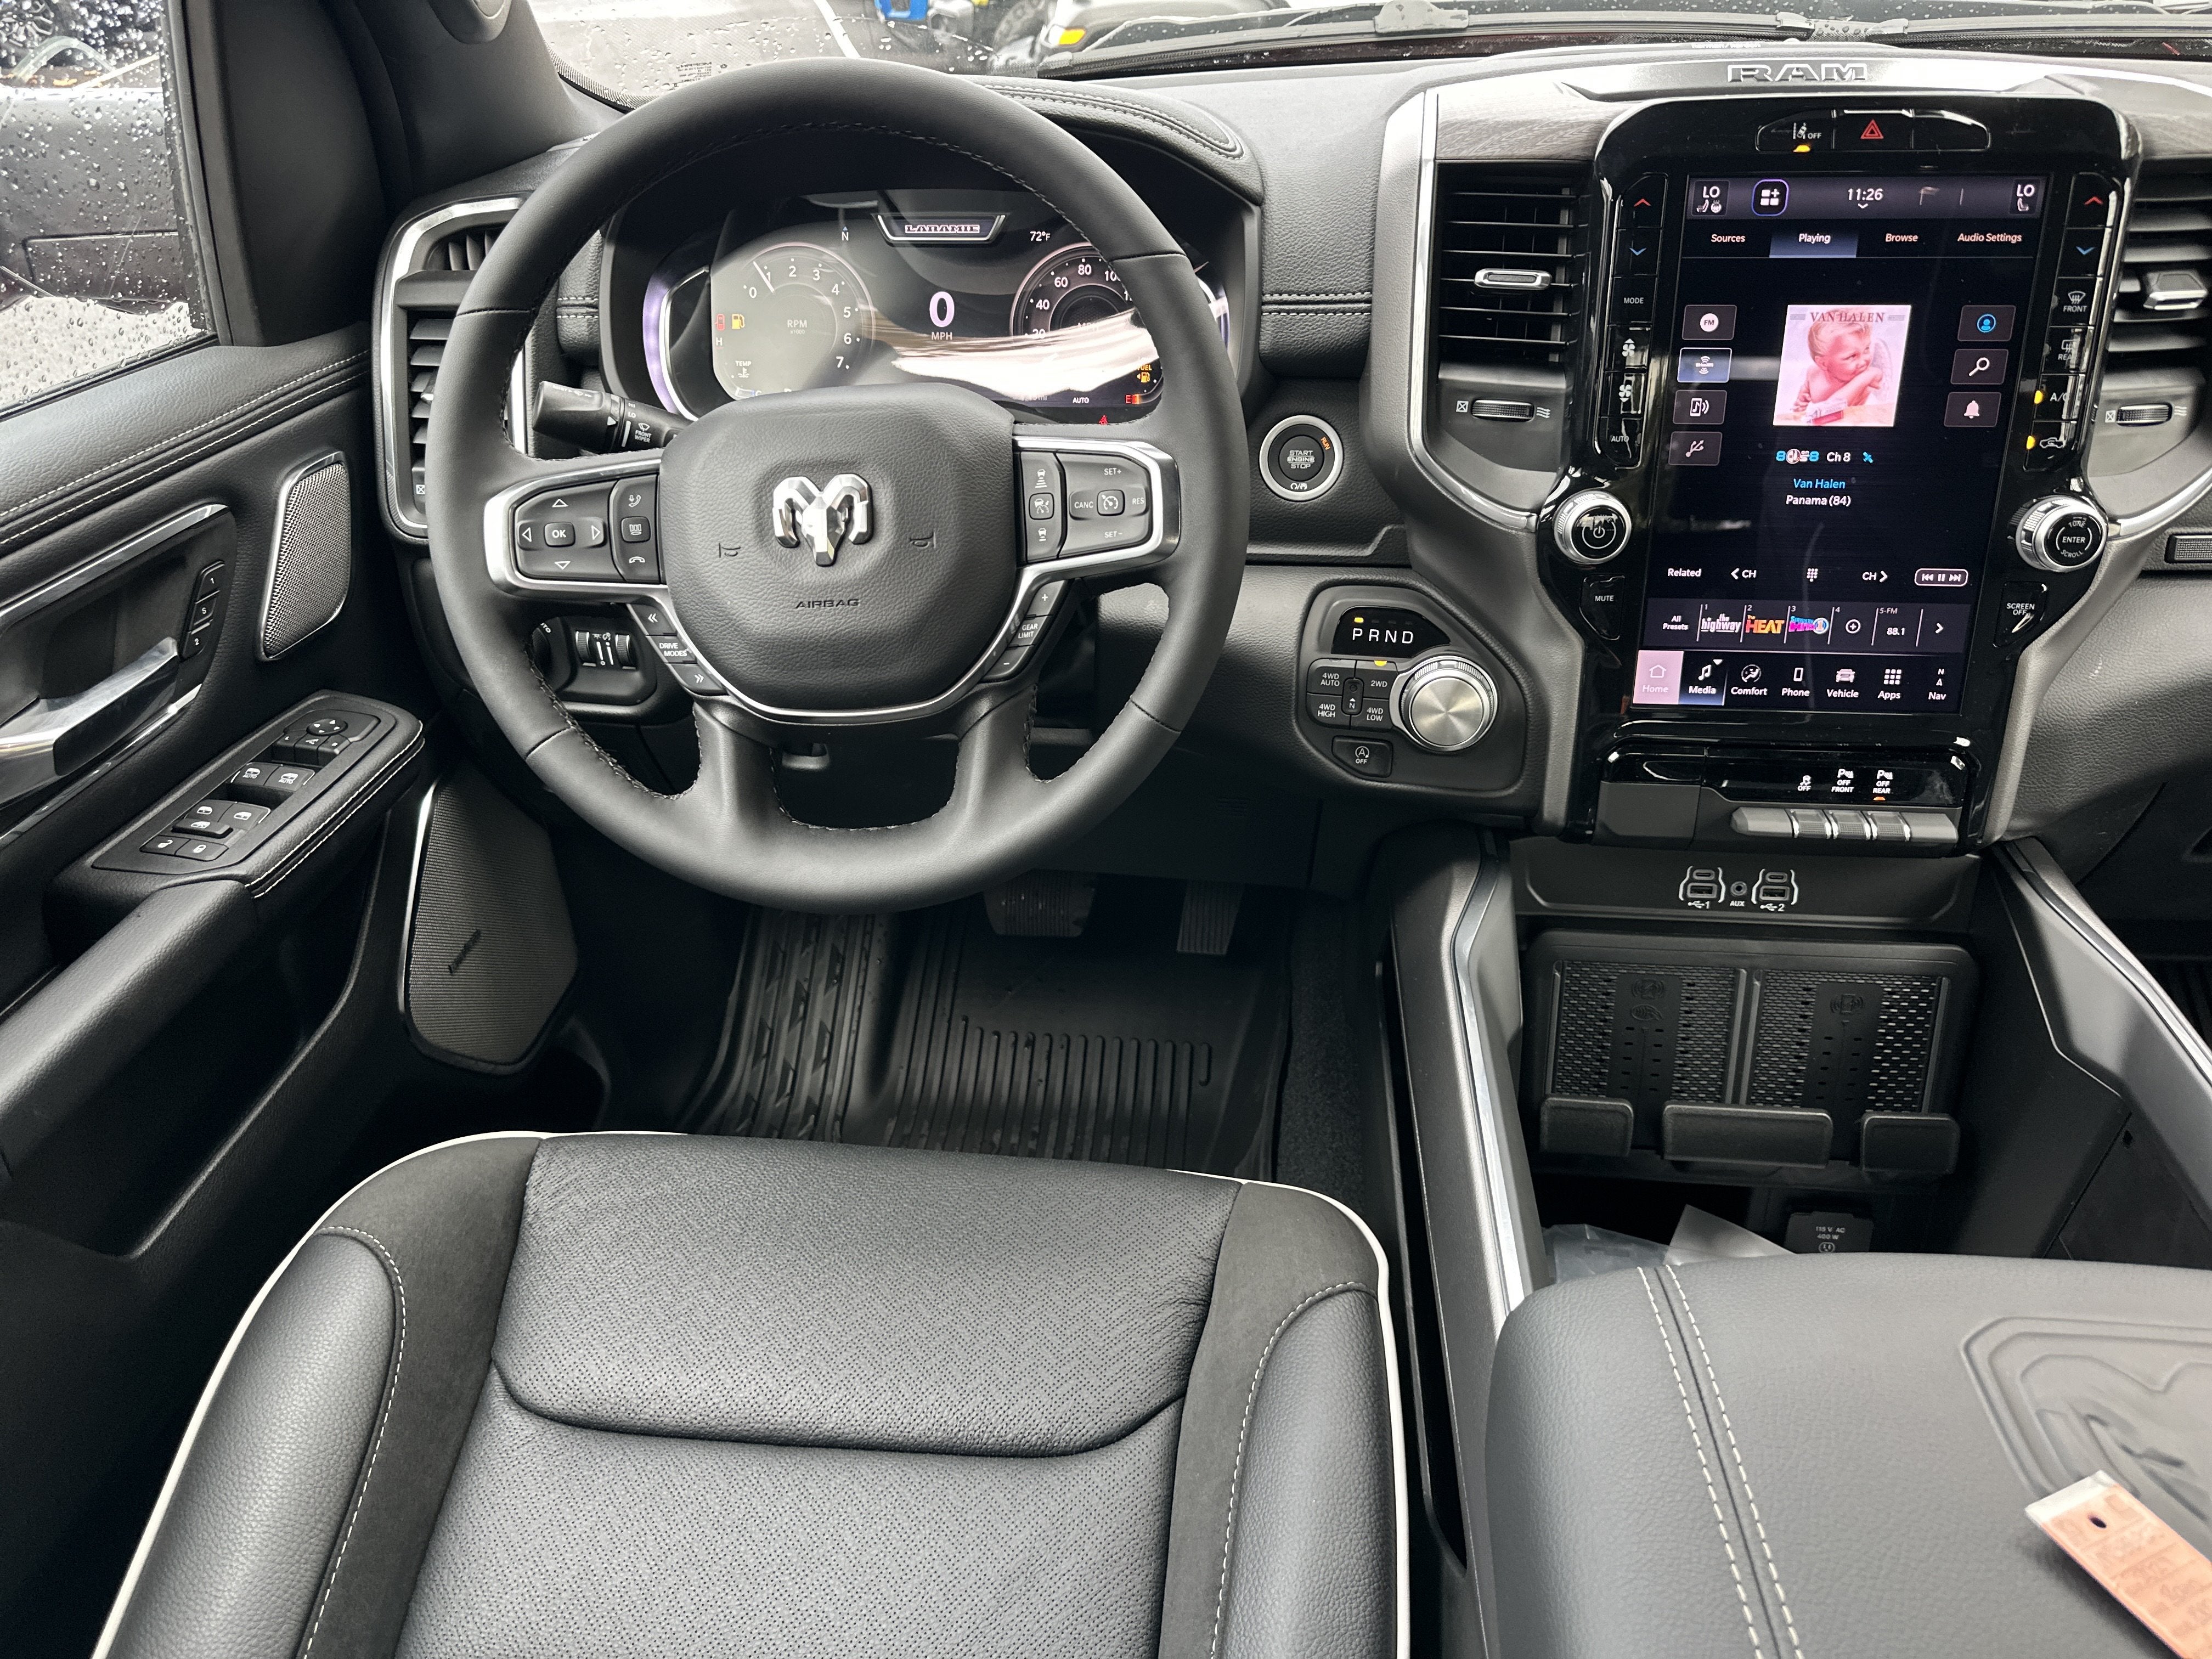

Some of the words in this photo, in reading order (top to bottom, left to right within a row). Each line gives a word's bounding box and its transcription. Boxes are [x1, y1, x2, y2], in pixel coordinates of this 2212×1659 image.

[1728, 64, 1867, 82] RAM
[1702, 186, 1720, 199] LO
[1847, 188, 1884, 201] 11:26
[2016, 184, 2035, 197] LO
[841, 232, 849, 241] N
[1030, 231, 1051, 241] 72°F
[1711, 234, 1746, 243] Sources
[1798, 233, 1831, 244] Playing
[1885, 233, 1918, 242] Browse
[1957, 233, 1985, 242] Audio
[1985, 233, 2023, 244] Settings
[789, 266, 797, 277] 2
[1077, 264, 1092, 275] 80
[812, 269, 821, 281] 3
[1104, 270, 1121, 281] 10
[1054, 276, 1068, 287] 60
[749, 288, 757, 298] 0
[831, 284, 840, 295] 4
[929, 291, 955, 328] 0
[1035, 299, 1050, 310] 40
[843, 307, 851, 318] 5
[1810, 312, 1836, 323] VAN
[1838, 312, 1885, 323] HALEN
[787, 319, 808, 329] RPM
[843, 333, 852, 345] 6
[931, 332, 953, 340] MPH
[716, 337, 723, 346] H
[836, 357, 844, 368] 7
[1126, 395, 1131, 404] E
[635, 430, 652, 438] FRONT
[635, 434, 651, 443] WIPER
[1321, 437, 1331, 451] RUN
[1826, 452, 1842, 462] Ch
[1843, 452, 1852, 462] 8
[1793, 478, 1813, 488] Van
[1815, 478, 1846, 489] Halen
[1074, 501, 1094, 509] CANC
[1132, 497, 1144, 505] RES
[1786, 495, 1827, 505] Panama
[1829, 495, 1852, 507] (84)
[551, 529, 567, 539] OK
[2060, 549, 2084, 558] SCROLL
[1667, 568, 1702, 577] Related
[1741, 569, 1757, 578] CH
[1862, 572, 1877, 581] CH
[795, 598, 860, 609] AIRBAG
[1022, 623, 1039, 631] GEAR
[1662, 623, 1689, 631] Presets
[1701, 617, 1742, 633] highway
[1745, 619, 1785, 634] HEAT
[1018, 630, 1034, 639] LIMIT
[1352, 628, 1363, 641] P
[1368, 629, 1380, 642] R
[1385, 630, 1397, 644] N
[1402, 631, 1414, 644] D
[1886, 627, 1905, 635] 88.1
[194, 637, 200, 646] 2
[1322, 672, 1340, 680] 4WD
[1370, 680, 1388, 688] 2WD
[1641, 685, 1669, 693] Home
[1688, 686, 1717, 695] Media
[1730, 686, 1768, 696] Comfort
[1781, 688, 1810, 697] Phone
[1826, 689, 1859, 698] Vehicle
[1877, 690, 1901, 701] Apps
[1928, 692, 1946, 701] Nav
[1318, 703, 1336, 712] 4WD
[1366, 707, 1384, 715] 4WD
